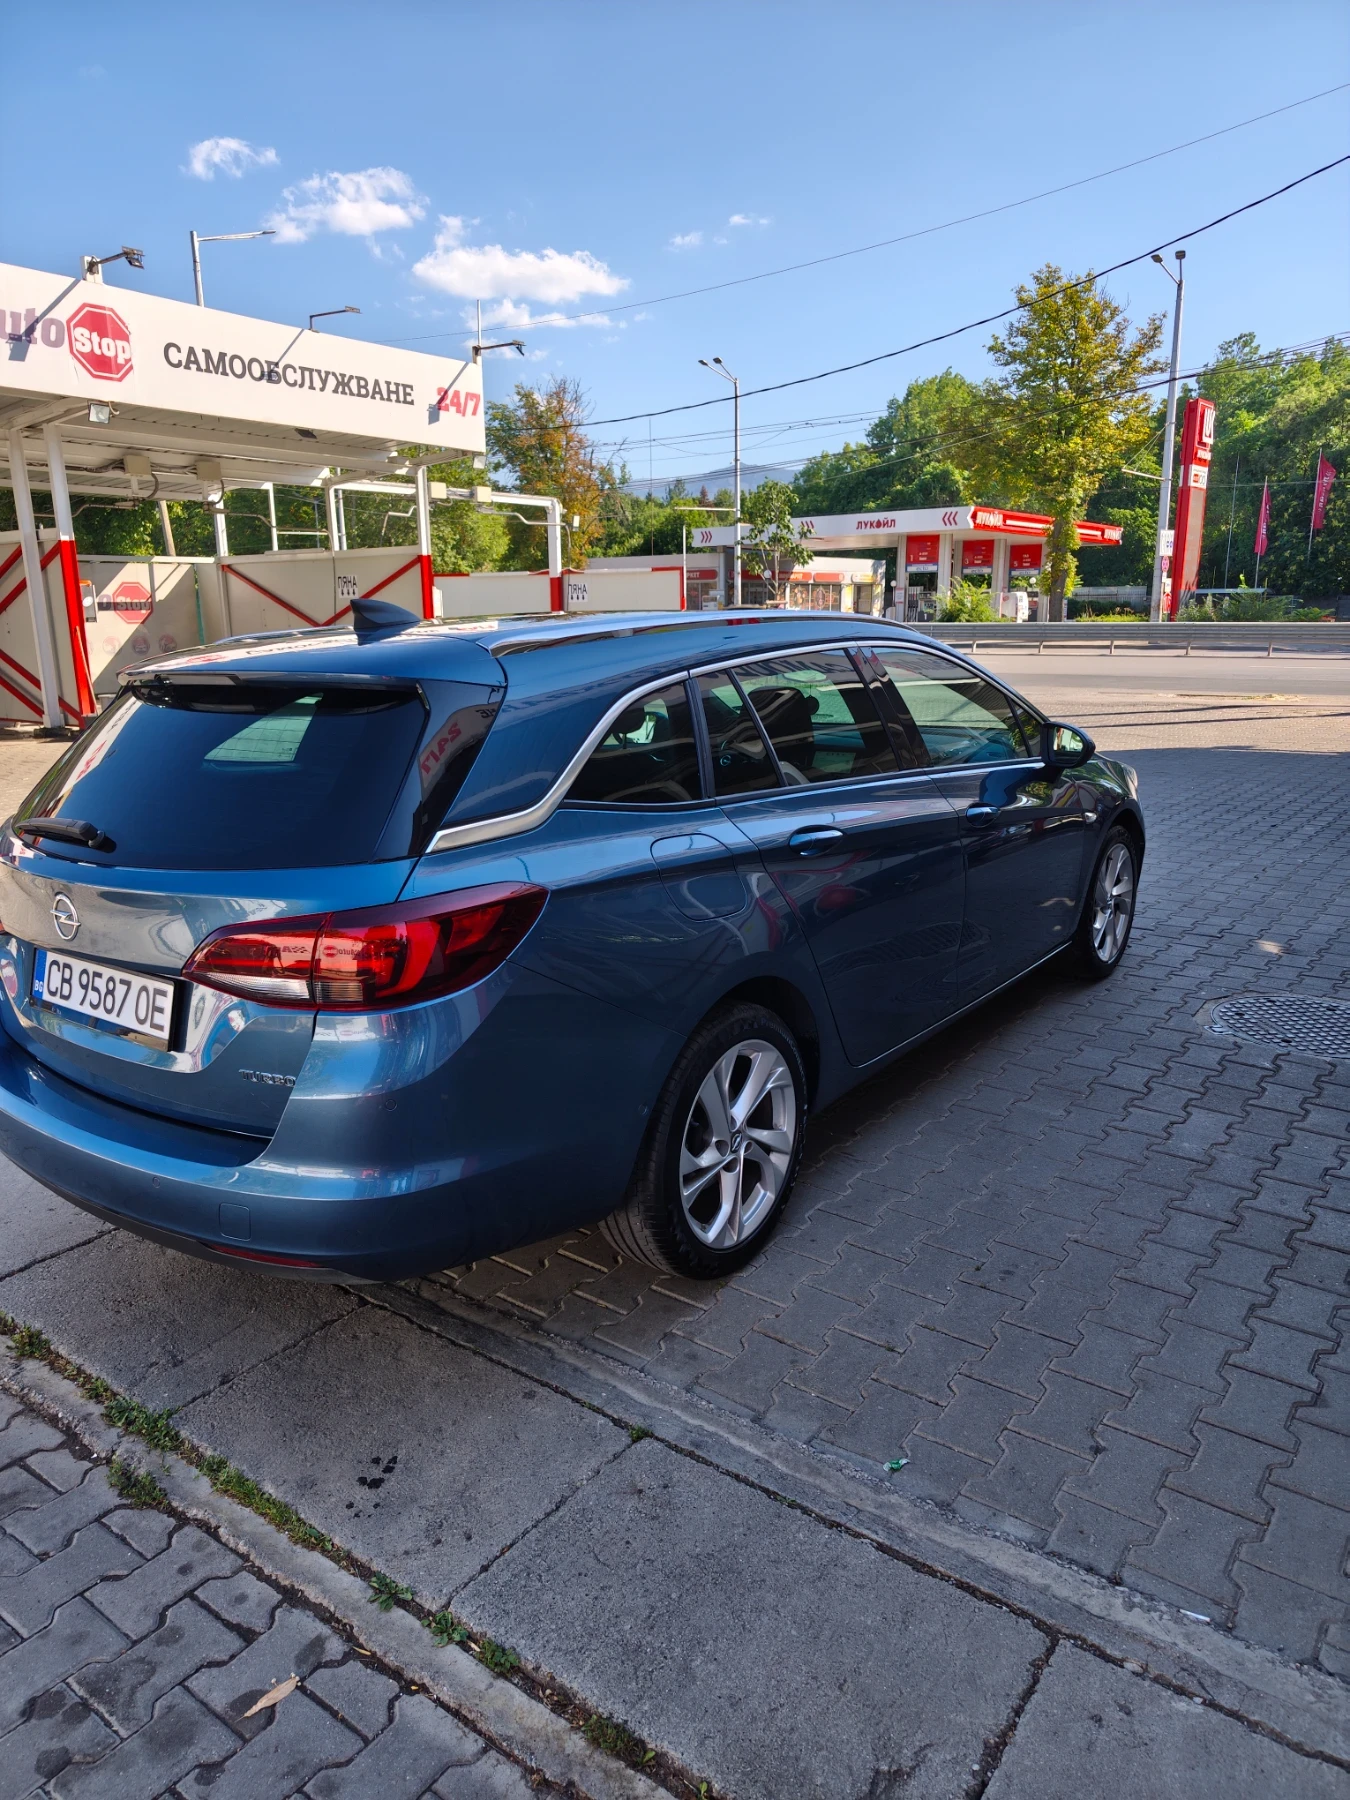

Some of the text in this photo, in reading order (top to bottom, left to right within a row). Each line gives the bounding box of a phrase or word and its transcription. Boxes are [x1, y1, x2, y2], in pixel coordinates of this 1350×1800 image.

[73, 327, 132, 364] Stop
[163, 342, 481, 417] САМООБСЛУЖВАНЕ 24/7
[337, 576, 358, 589] ПЯНА
[568, 583, 588, 595] ПЯНА
[116, 595, 151, 613] Stop
[34, 979, 44, 992] BG
[47, 959, 73, 1001] CB
[78, 968, 131, 1018] 9587
[238, 1068, 296, 1087] TURBO
